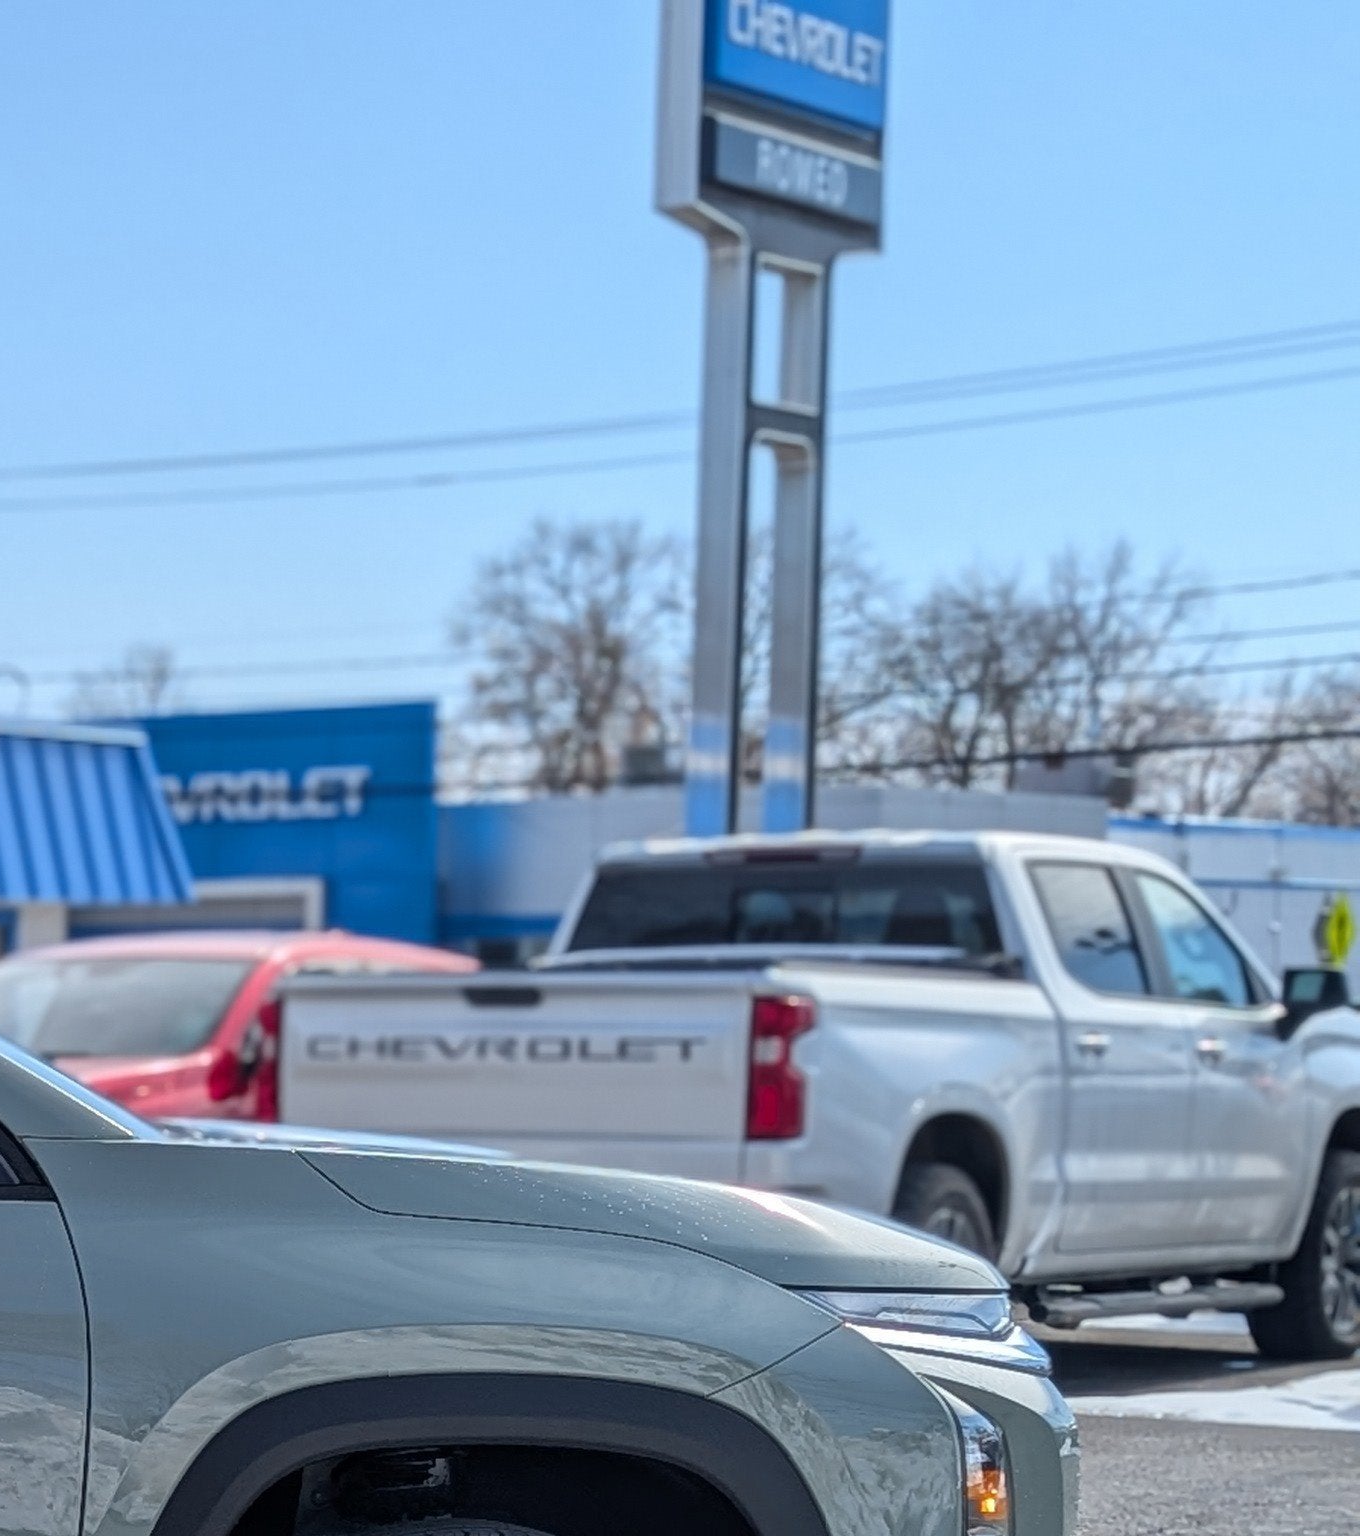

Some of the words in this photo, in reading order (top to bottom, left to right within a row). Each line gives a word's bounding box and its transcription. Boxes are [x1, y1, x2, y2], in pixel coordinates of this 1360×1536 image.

[727, 0, 884, 87] CHEVROLET
[162, 765, 370, 823] VROLET
[305, 1034, 709, 1063] CHEVROLET
